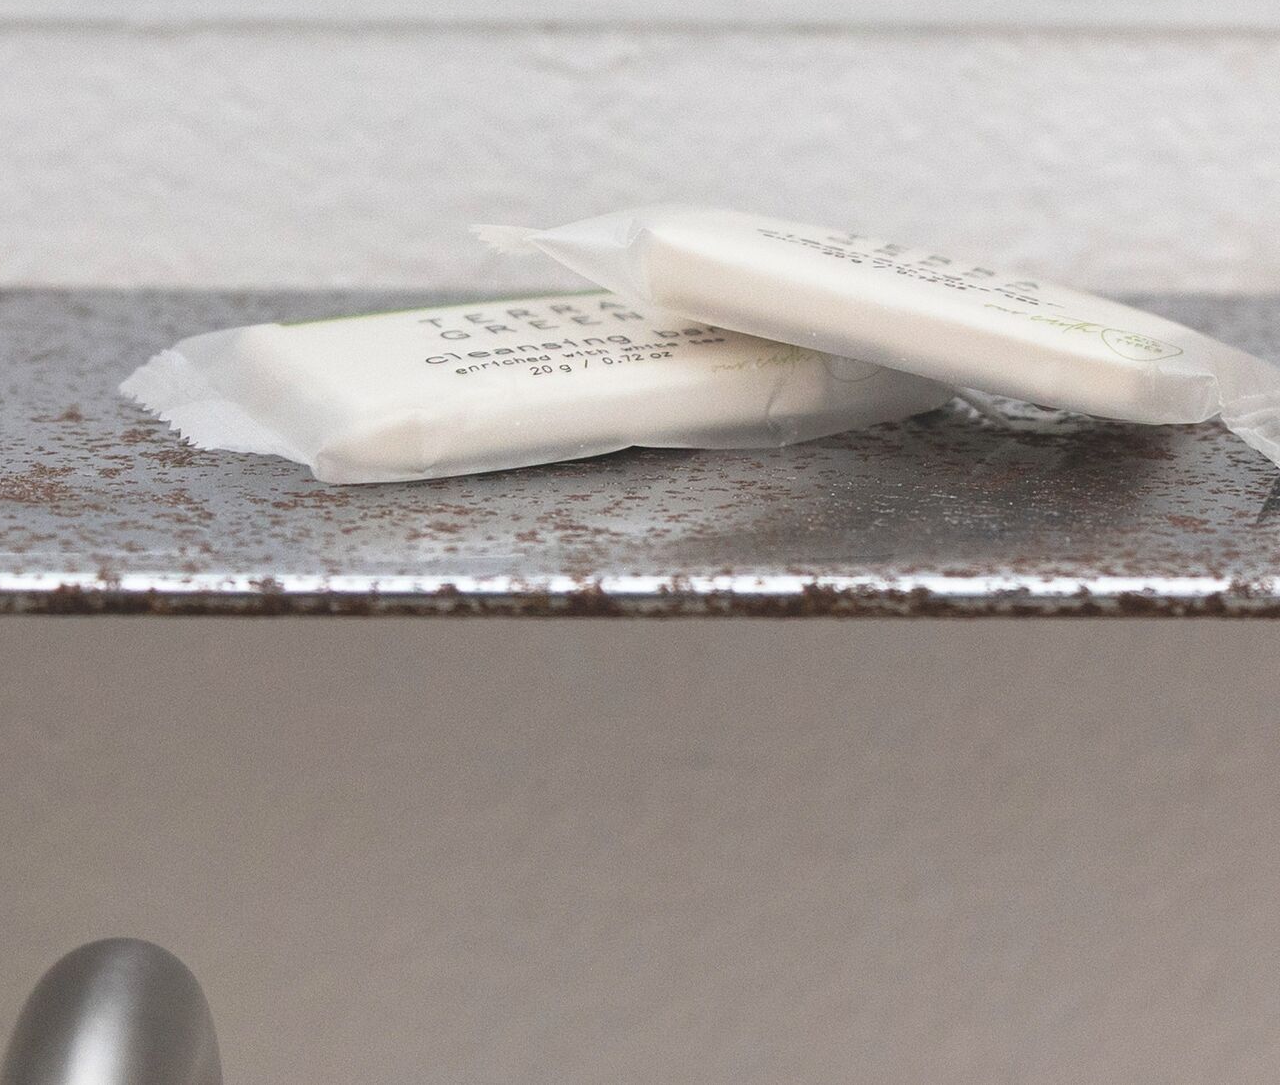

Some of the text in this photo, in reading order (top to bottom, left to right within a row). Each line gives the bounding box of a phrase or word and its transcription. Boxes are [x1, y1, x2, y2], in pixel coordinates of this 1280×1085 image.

[418, 300, 627, 329] TERRA
[440, 311, 644, 341] GREEN
[425, 333, 632, 366] cleansing
[455, 353, 551, 376] enriched
[562, 347, 610, 360] with
[620, 341, 680, 353] white
[529, 364, 553, 377] 20
[558, 363, 573, 374] g
[602, 352, 644, 367] 0.72
[649, 350, 675, 359] oz
